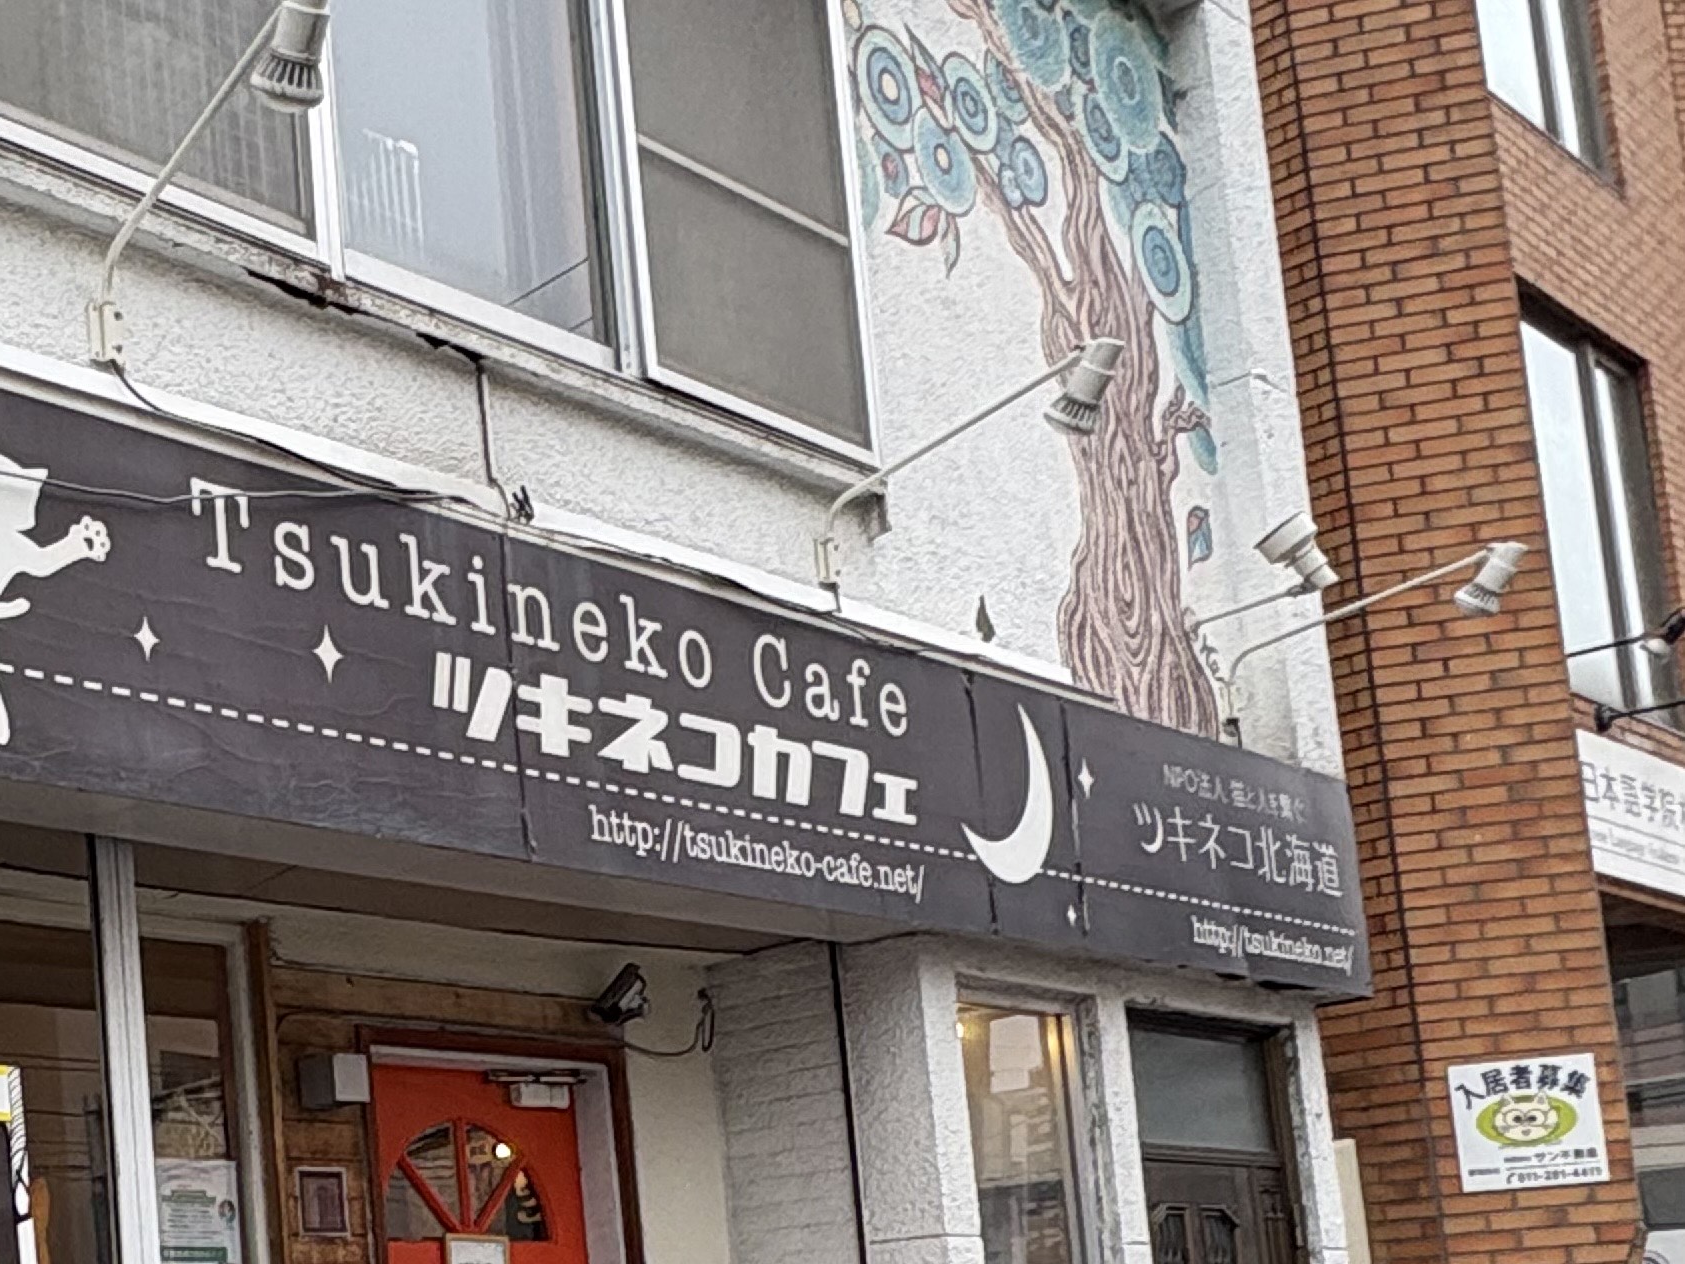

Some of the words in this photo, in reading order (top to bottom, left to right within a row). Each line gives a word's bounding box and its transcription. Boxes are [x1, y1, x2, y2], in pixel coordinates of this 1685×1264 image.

[189, 476, 714, 689] Tsukineko
[753, 635, 910, 737] Cafe
[432, 651, 918, 827] ツキネコカフェ
[589, 803, 926, 904] http://tsukineko-cafe.net/
[1132, 802, 1344, 898] ツキネコ北海道
[1453, 1064, 1591, 1110] 入居者募集
